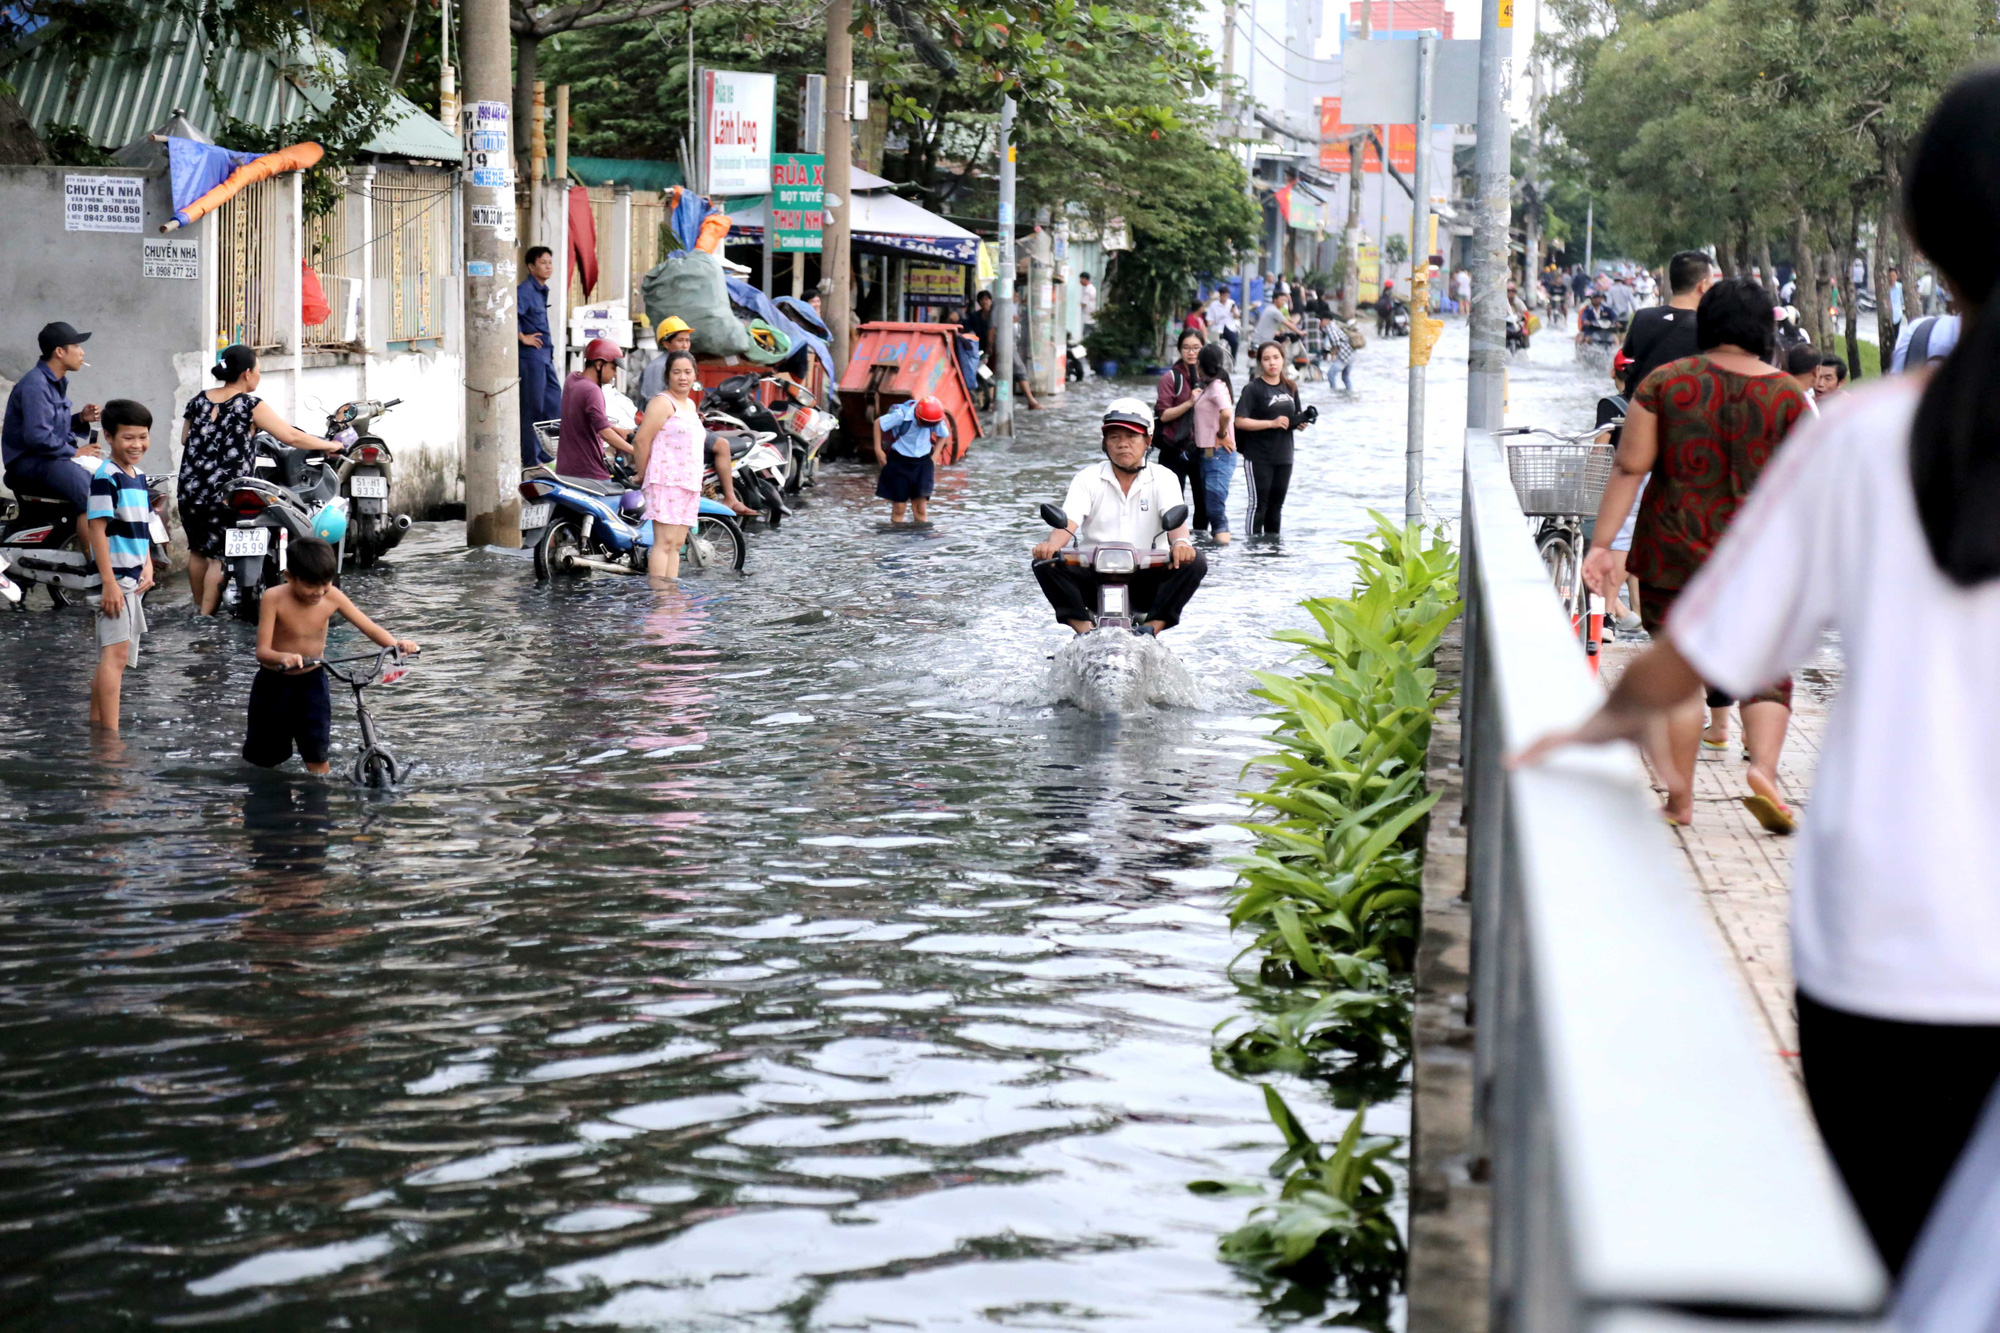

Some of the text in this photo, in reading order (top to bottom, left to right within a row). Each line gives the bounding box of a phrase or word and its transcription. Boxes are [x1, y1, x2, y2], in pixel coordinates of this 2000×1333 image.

[736, 111, 757, 152] Long
[773, 156, 808, 186] RỬA
[812, 165, 824, 186] X
[66, 181, 142, 197] CHUYỂN NHÀ
[780, 187, 824, 205] BỌT TUYẾ
[67, 204, 140, 214] (08)99.950.950
[773, 210, 802, 230] THAY
[144, 240, 196, 259] CHUYỂN NHÀ
[144, 266, 196, 278] LH: 0908 477 224
[854, 342, 935, 362] LOAN
[232, 530, 261, 542] 59-X2
[228, 542, 264, 554] 285.99
